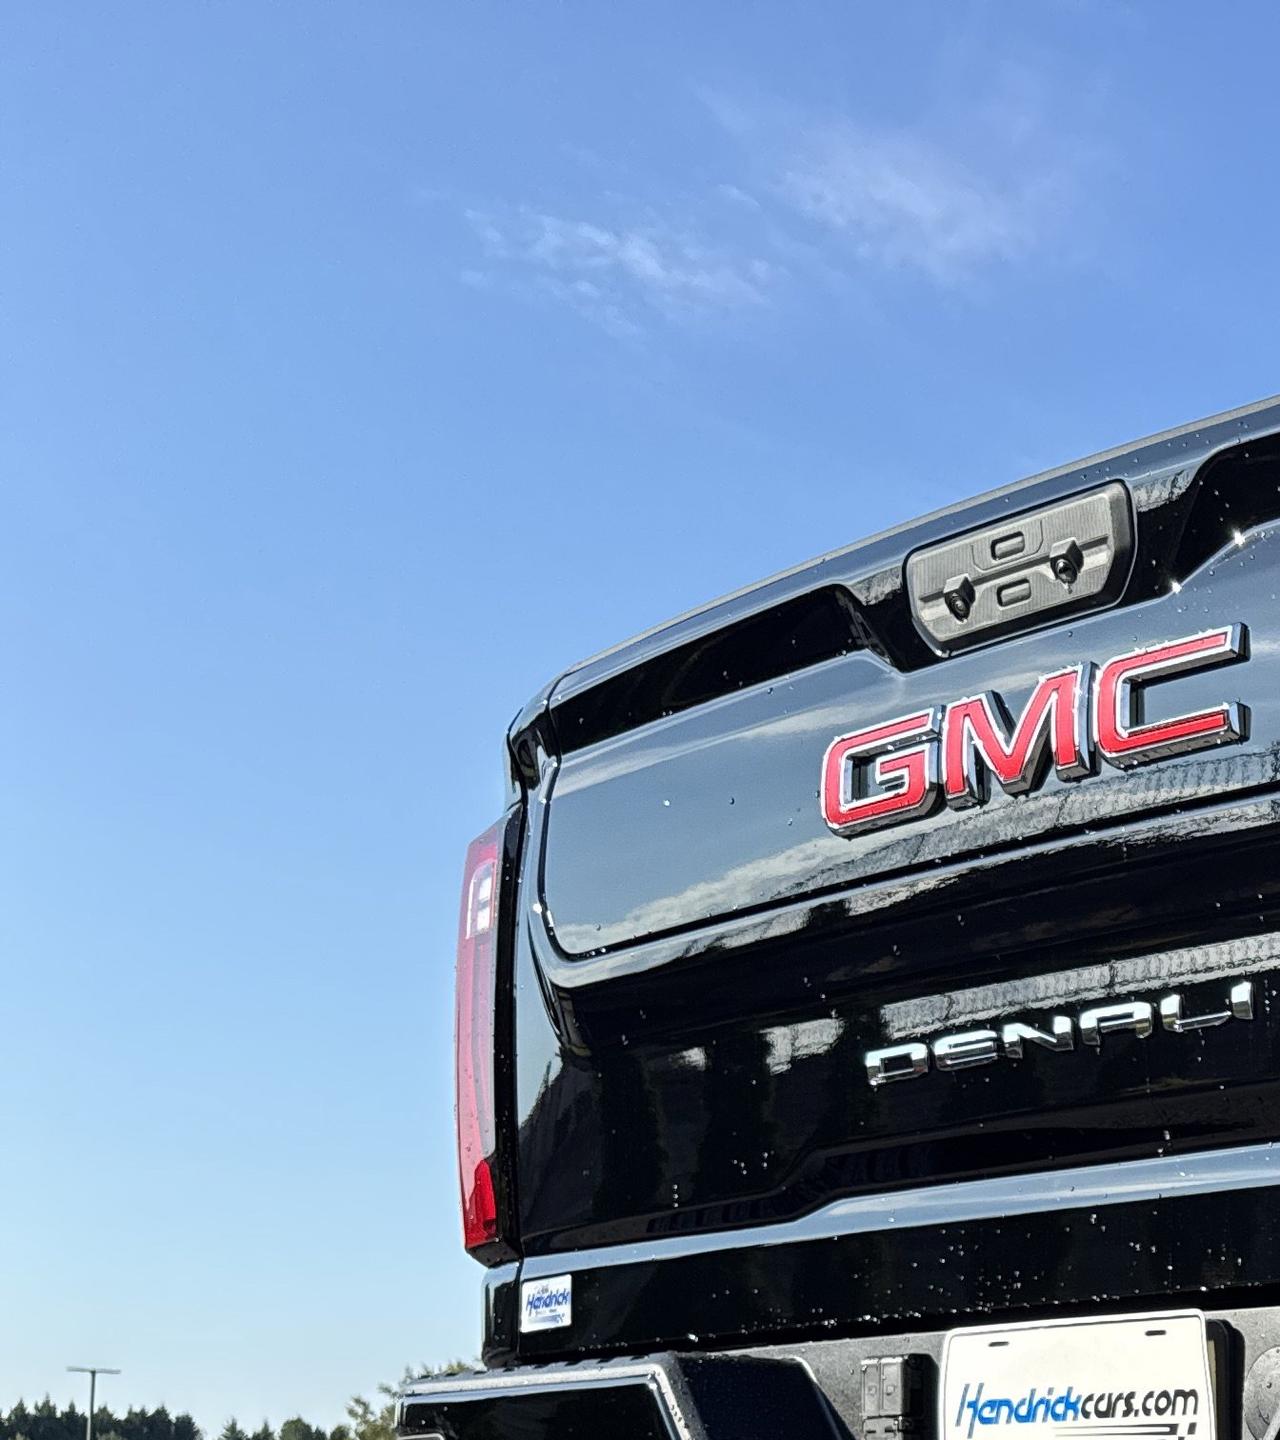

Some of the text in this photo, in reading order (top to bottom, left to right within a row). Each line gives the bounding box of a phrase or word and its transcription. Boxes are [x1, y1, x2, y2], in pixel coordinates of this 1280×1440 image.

[820, 622, 1251, 838] GMC
[865, 981, 1253, 1086] DENALI
[955, 1383, 1199, 1439] Hendrickcars.com
